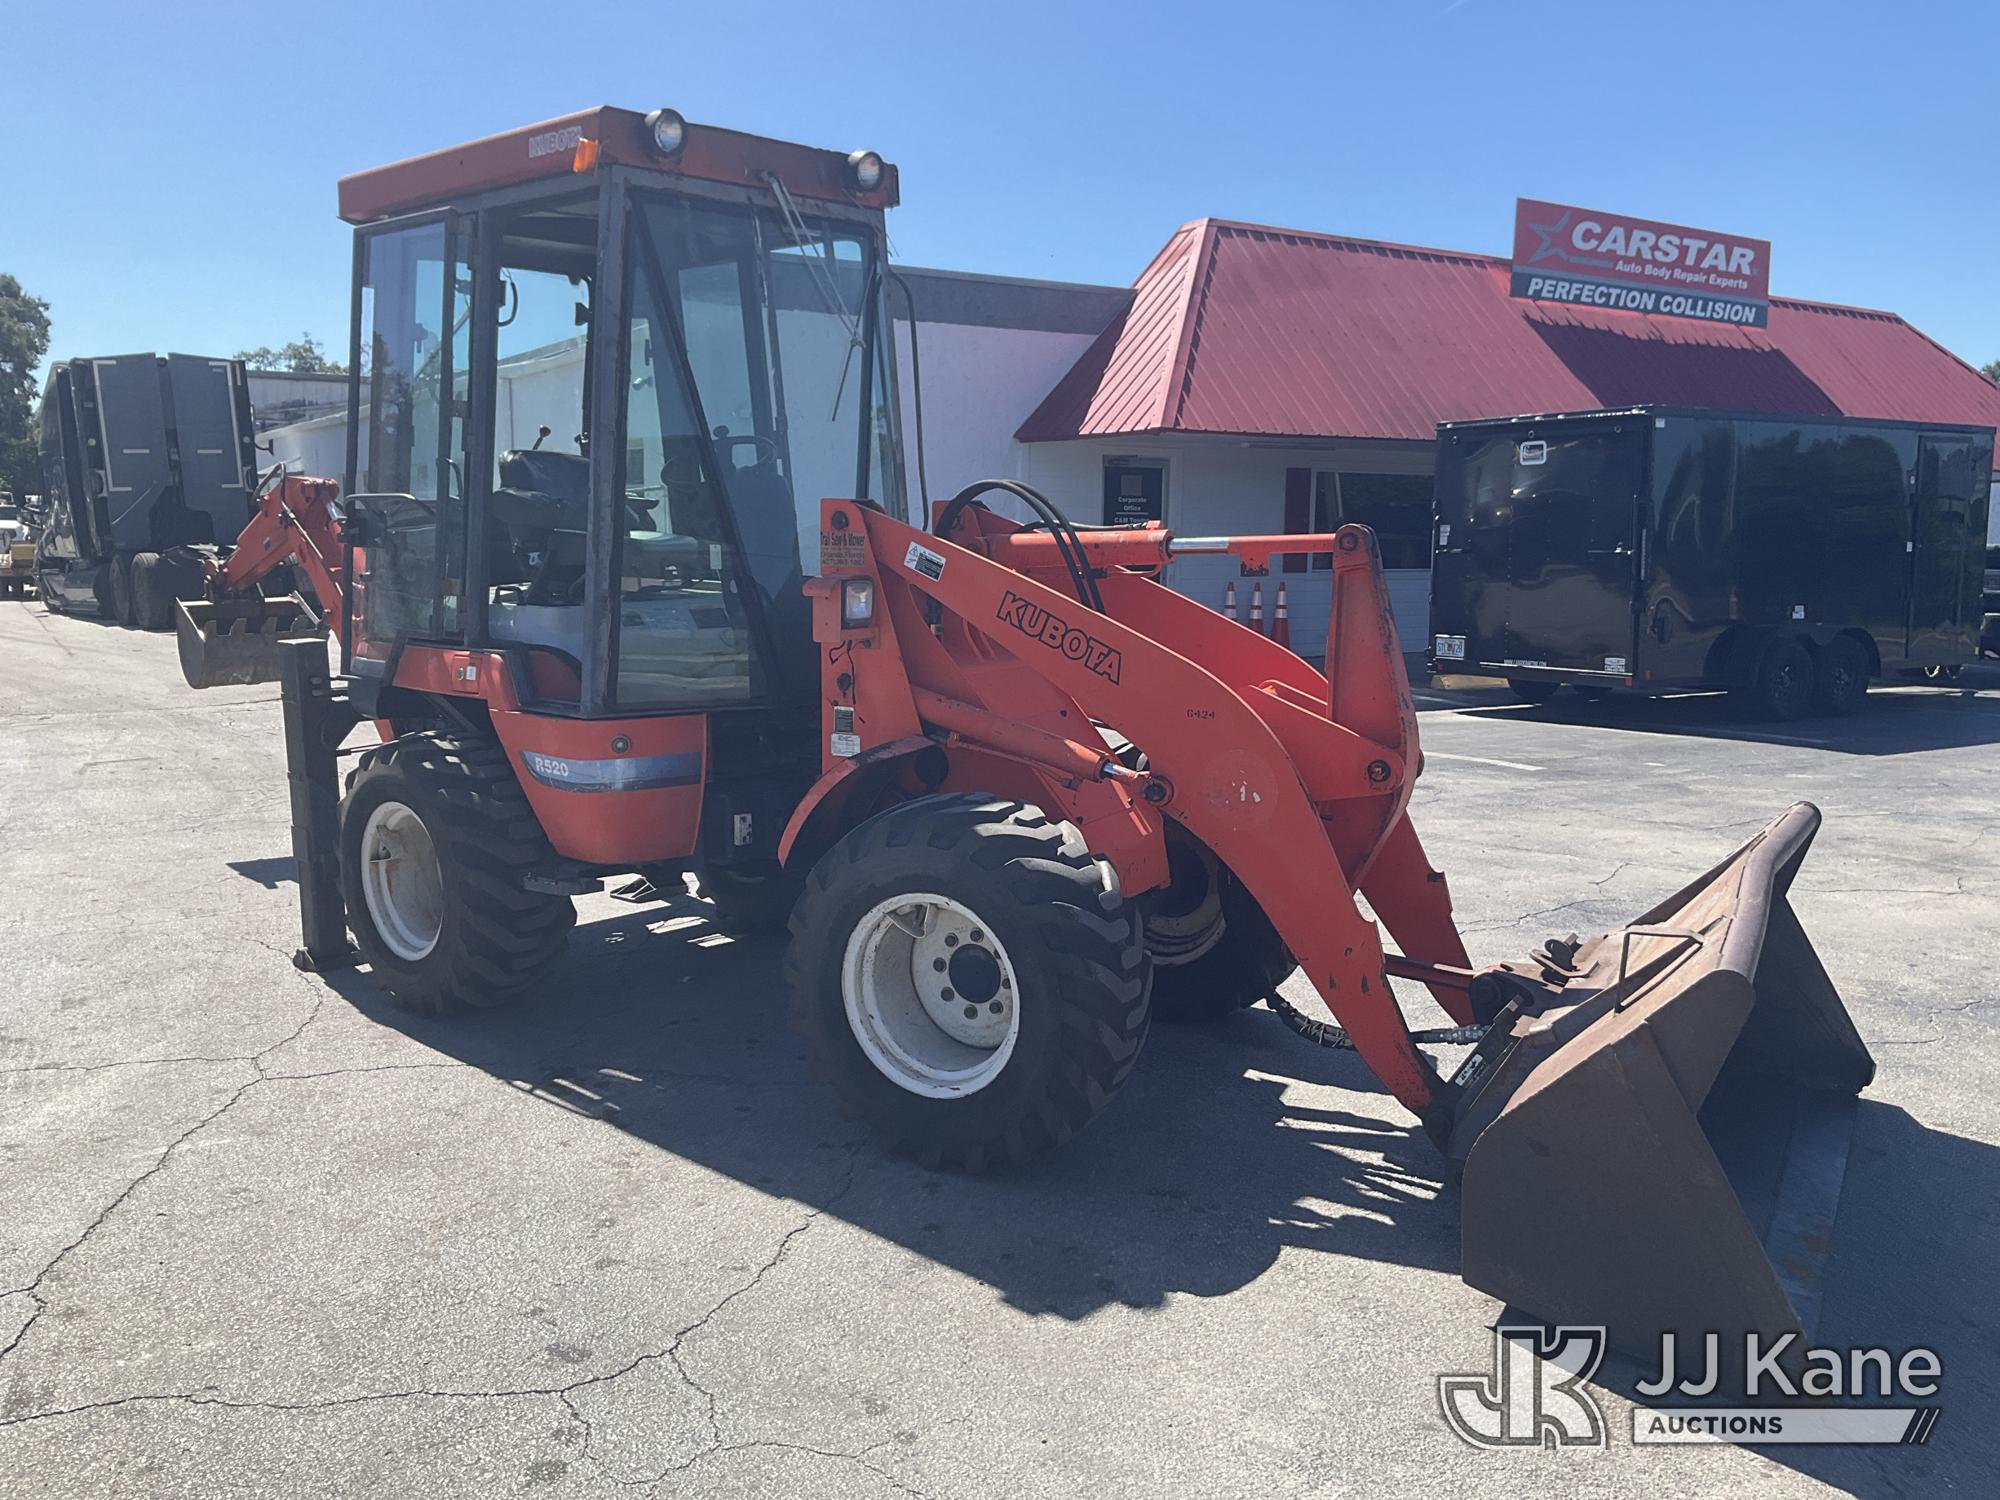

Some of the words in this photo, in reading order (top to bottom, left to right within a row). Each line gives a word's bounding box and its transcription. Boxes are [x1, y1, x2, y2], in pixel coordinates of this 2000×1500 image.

[1571, 221, 1755, 275] CARSTAR
[1615, 260, 1642, 274] Auto
[1644, 264, 1671, 281] Body
[1672, 269, 1707, 285] Repair
[1708, 274, 1748, 290] Experts
[1527, 277, 1657, 310] PERFECTION
[1659, 295, 1756, 323] COLLISION
[996, 590, 1122, 686] KUBOTA
[535, 756, 569, 777] R520
